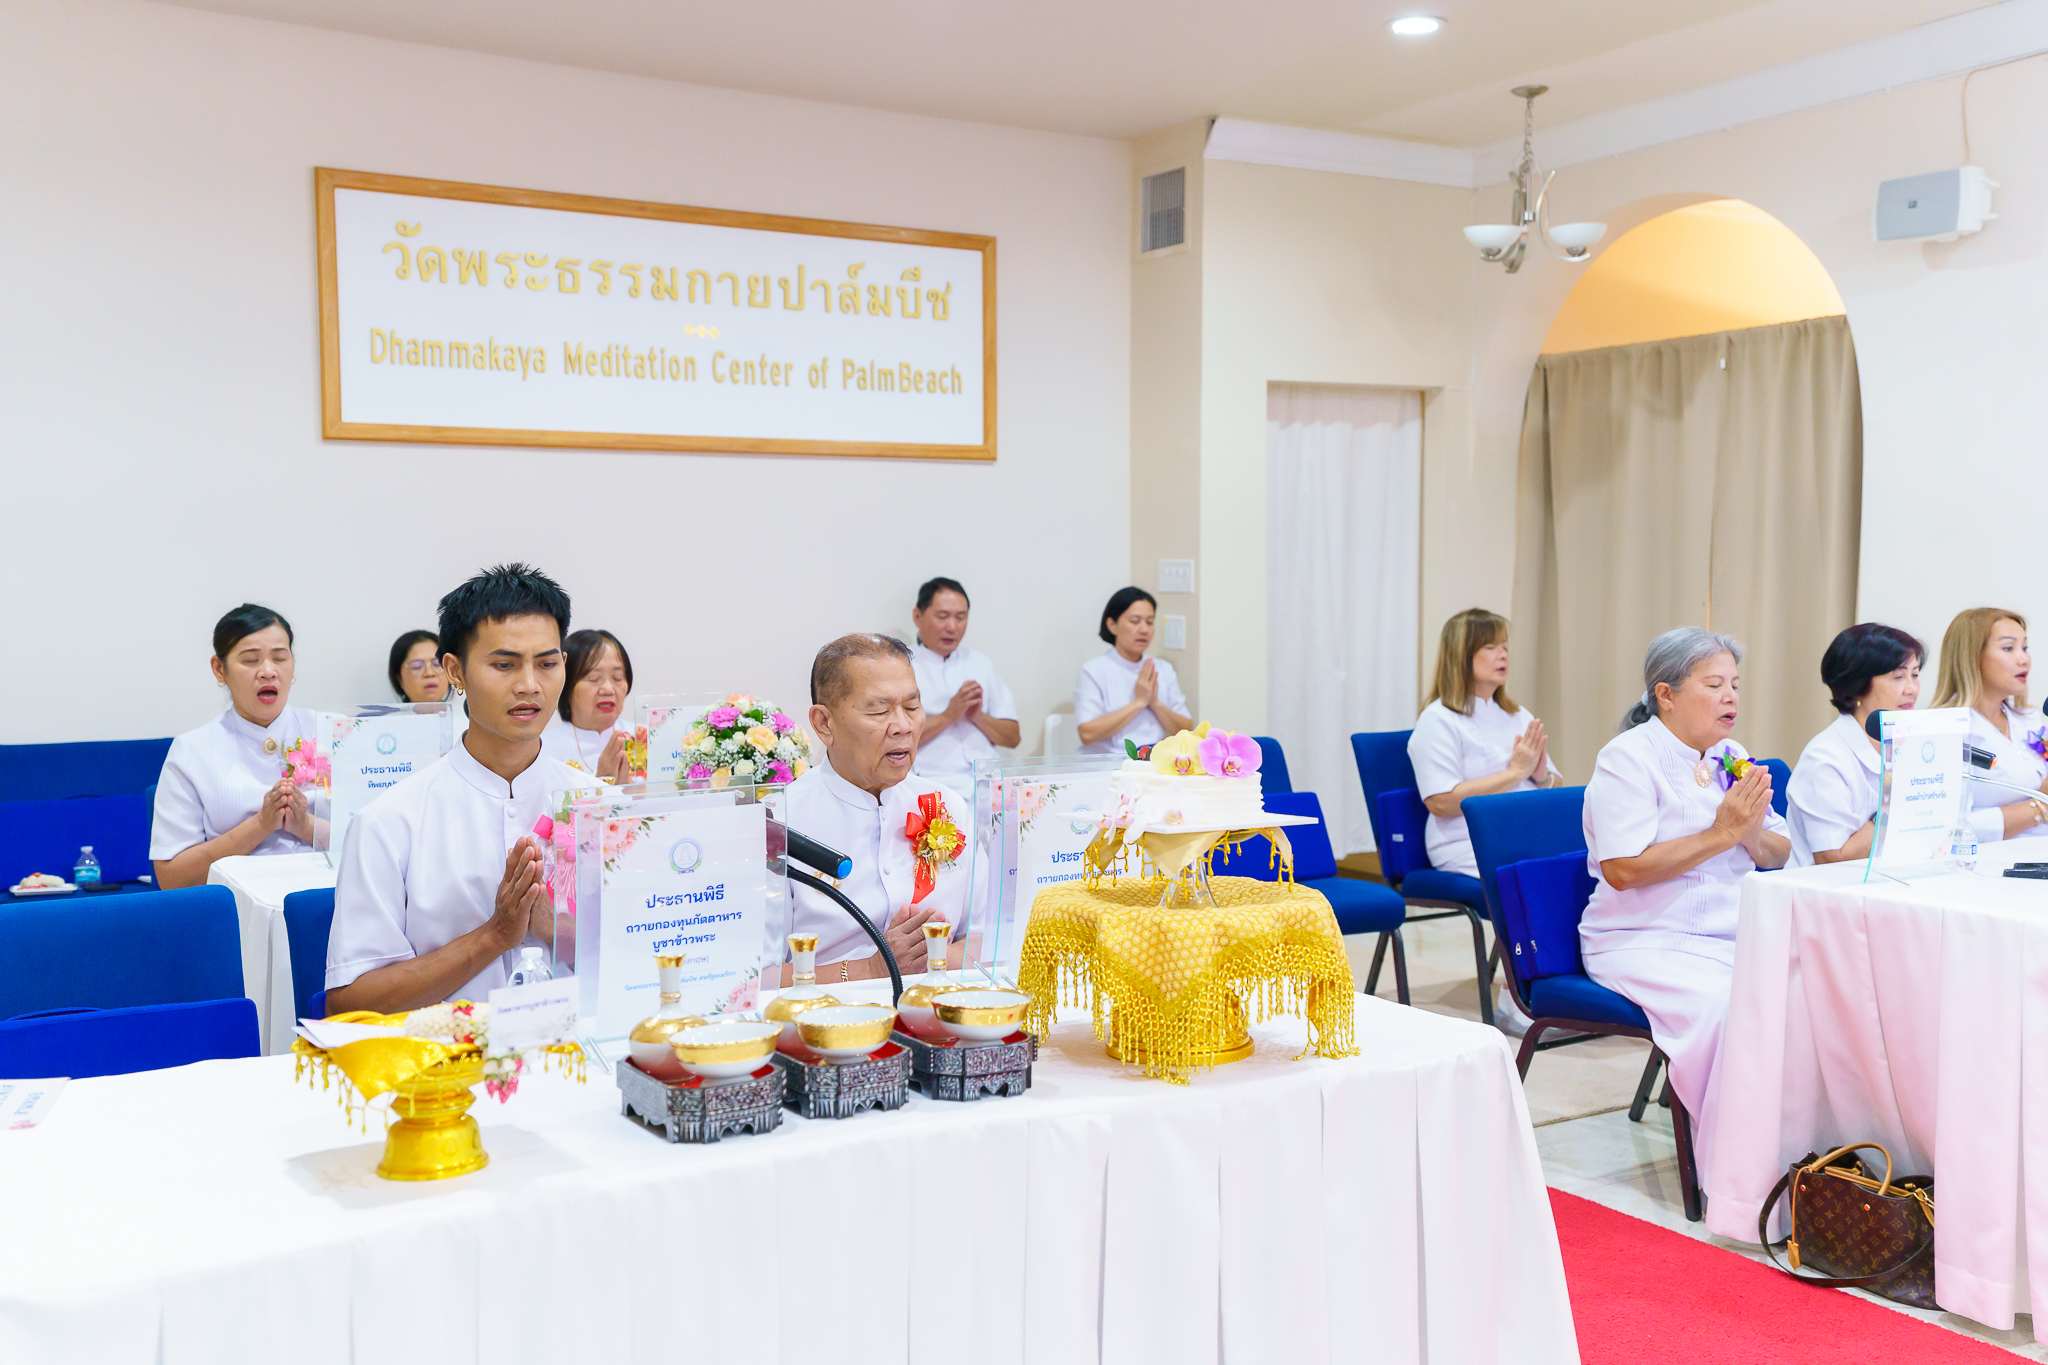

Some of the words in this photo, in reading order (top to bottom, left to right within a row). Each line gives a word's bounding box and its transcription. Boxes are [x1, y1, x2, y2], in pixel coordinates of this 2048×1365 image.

[382, 221, 952, 320] วัดพระธรรมกายปาล์มบีช
[371, 327, 546, 380] Dhammakaya
[564, 341, 697, 381] Meditation
[712, 350, 793, 386] Center
[808, 357, 829, 388] of
[843, 358, 962, 394] PalmBeach
[360, 762, 412, 775] ประธานพิธี
[645, 883, 725, 909] ประธานพิธี
[625, 911, 743, 934] ถวายกองทุนภัตตาหาร
[652, 933, 716, 953] บูชาข้าวพระ
